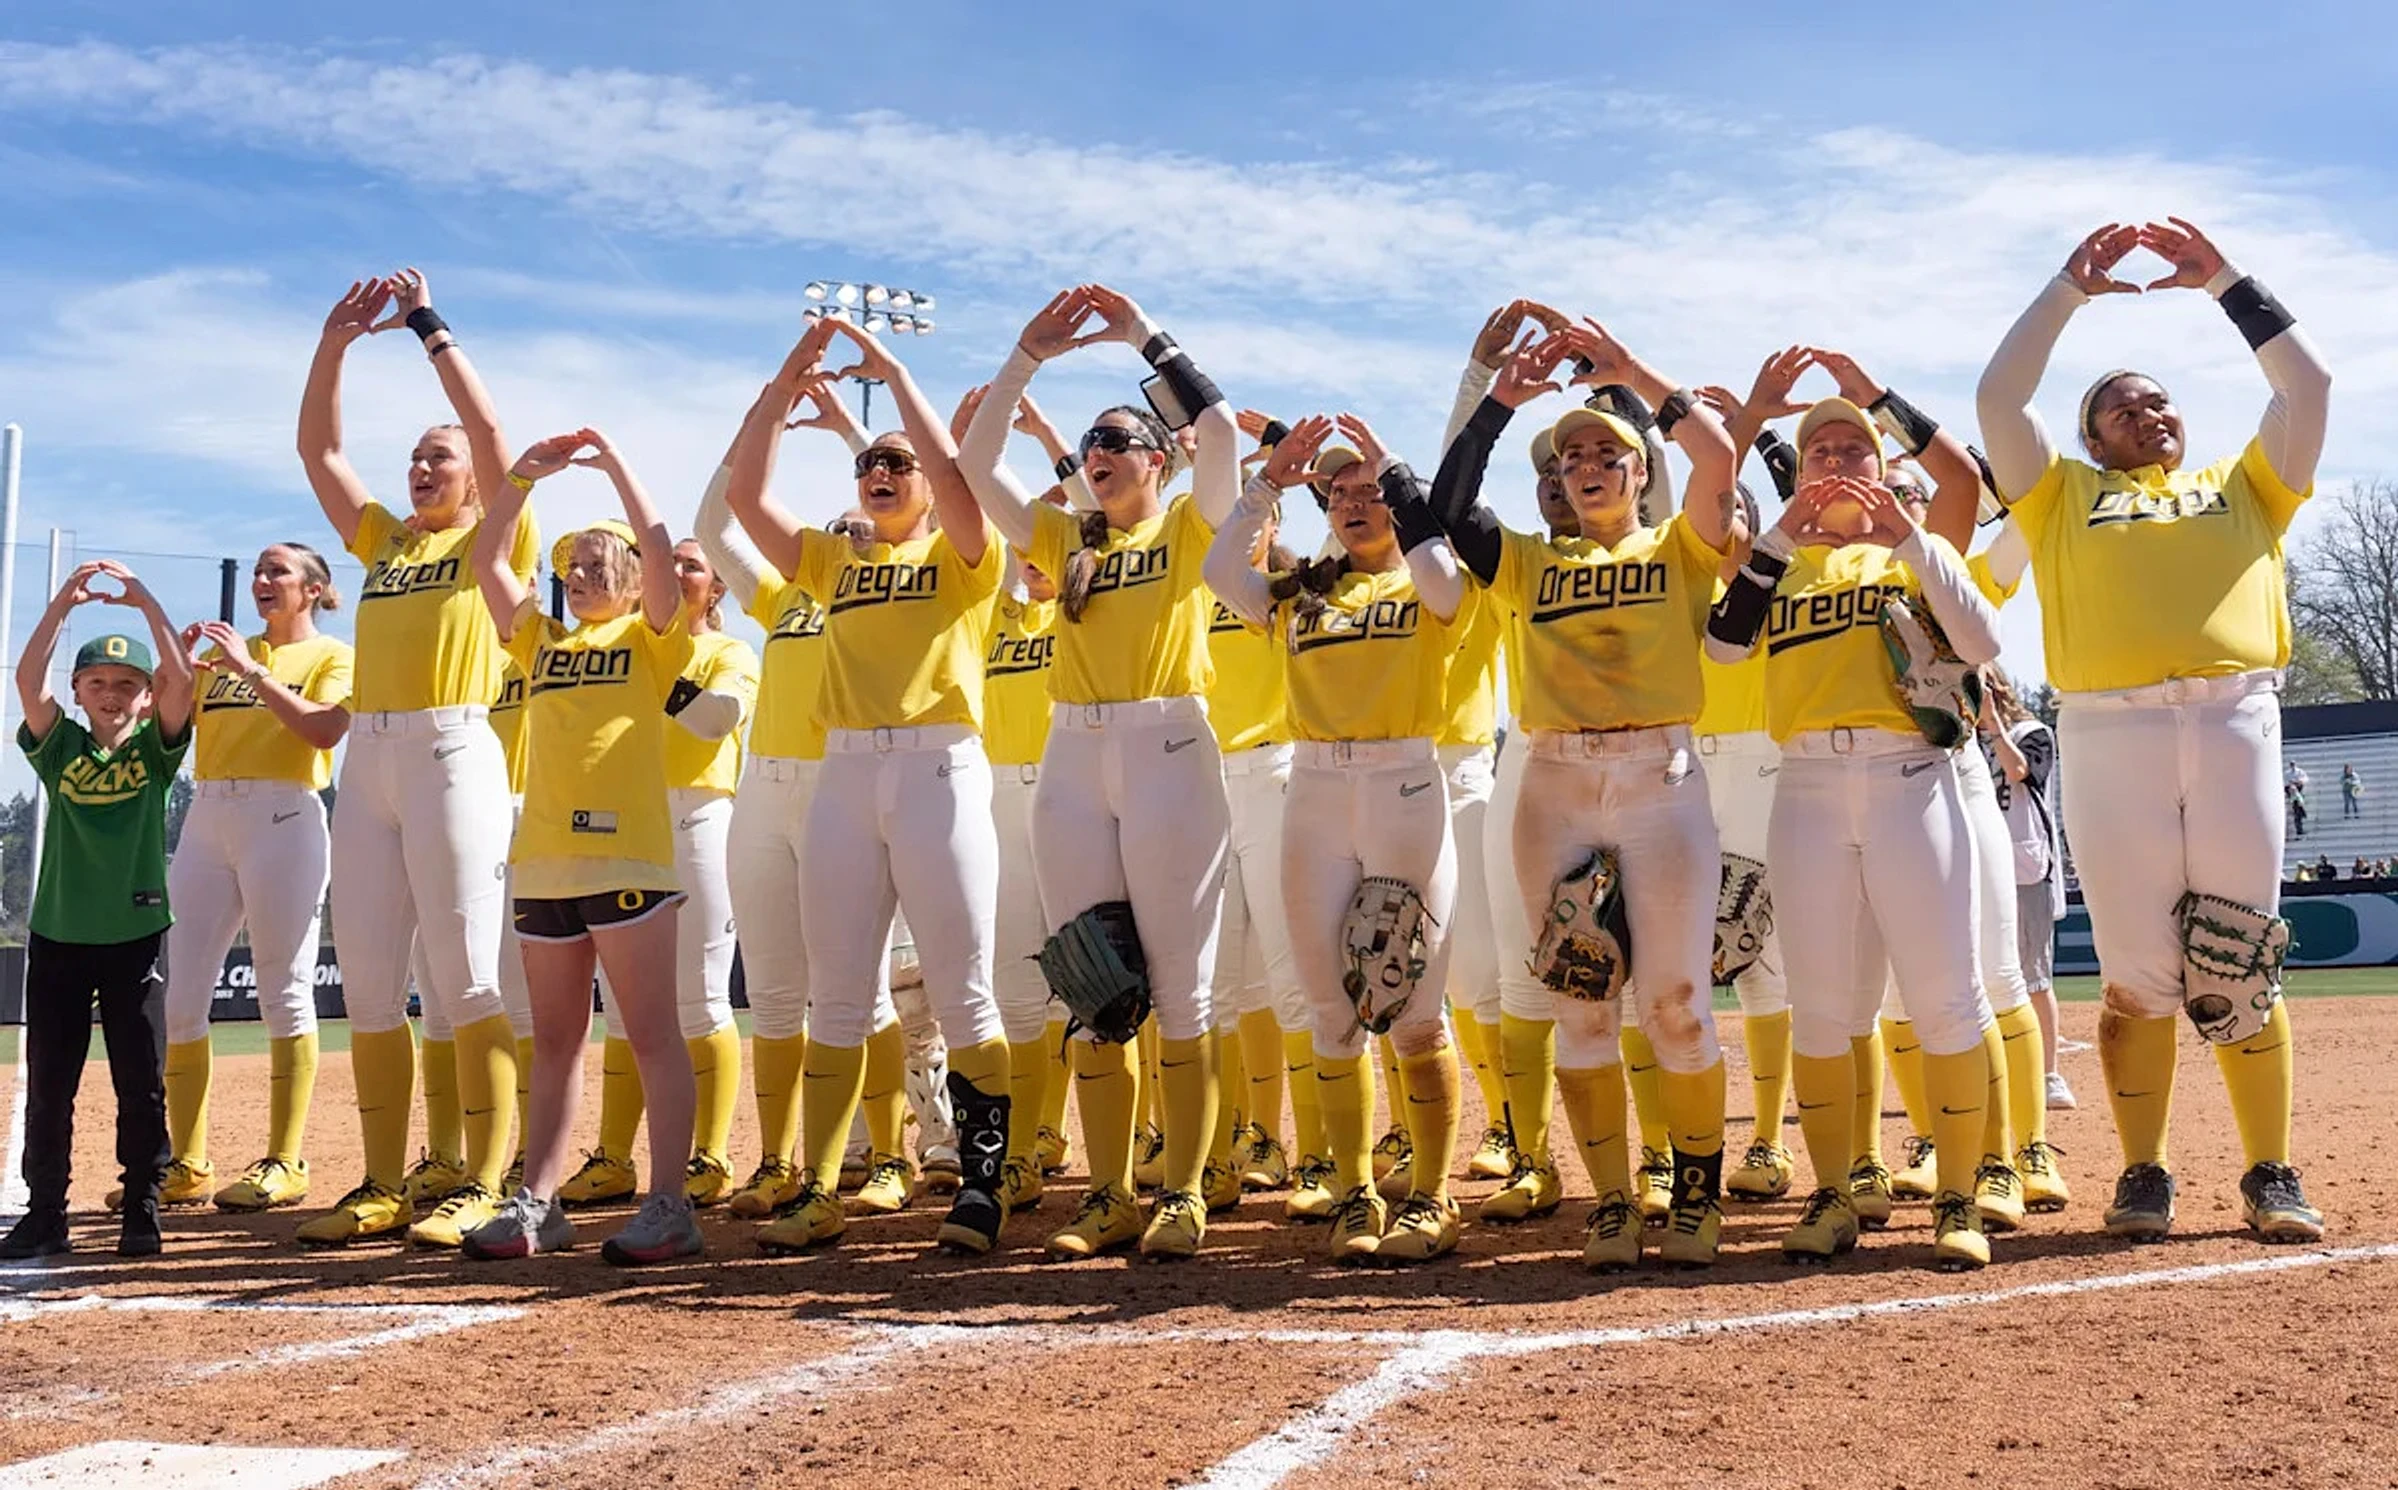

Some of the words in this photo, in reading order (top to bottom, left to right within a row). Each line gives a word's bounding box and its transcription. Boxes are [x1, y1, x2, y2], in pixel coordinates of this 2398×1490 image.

[1537, 564, 1666, 607] Oregon
[107, 637, 128, 658] O
[617, 889, 644, 911] O
[1381, 963, 1403, 988] O
[1683, 1166, 1706, 1186] O
